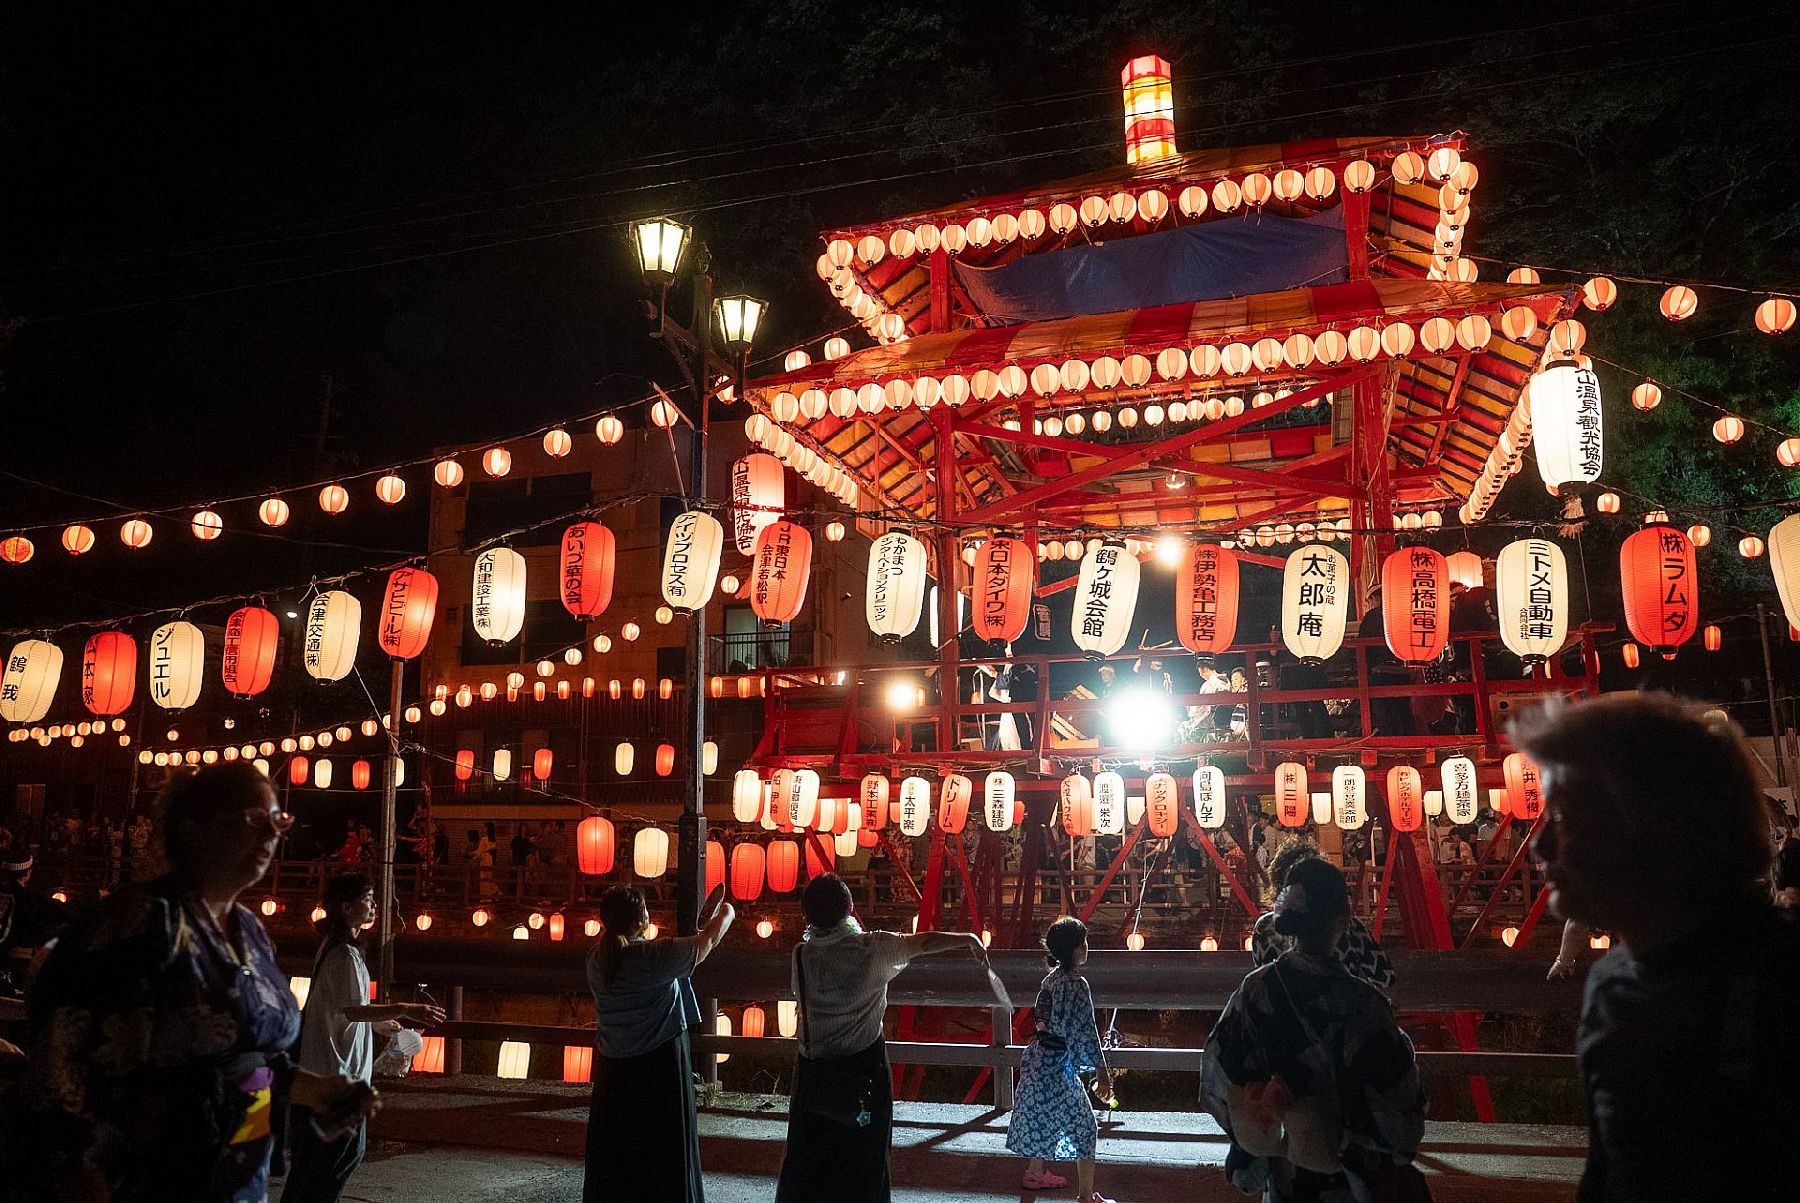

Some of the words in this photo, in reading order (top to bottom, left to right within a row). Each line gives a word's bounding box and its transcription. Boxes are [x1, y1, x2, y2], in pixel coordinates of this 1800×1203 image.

[756, 544, 774, 604] 会津若松駅
[772, 525, 791, 580] JR東日本
[891, 537, 908, 576] わかまつ
[1297, 553, 1327, 637] 太郎庵
[1325, 554, 1337, 606] お菓子の蔵
[1529, 543, 1553, 639] ミトメ自動車
[1520, 608, 1529, 640] 合同会社
[3, 655, 27, 701] 鶴我
[154, 628, 175, 699] ジュエル
[903, 796, 916, 830] 太平楽
[943, 778, 960, 828] ドリーム
